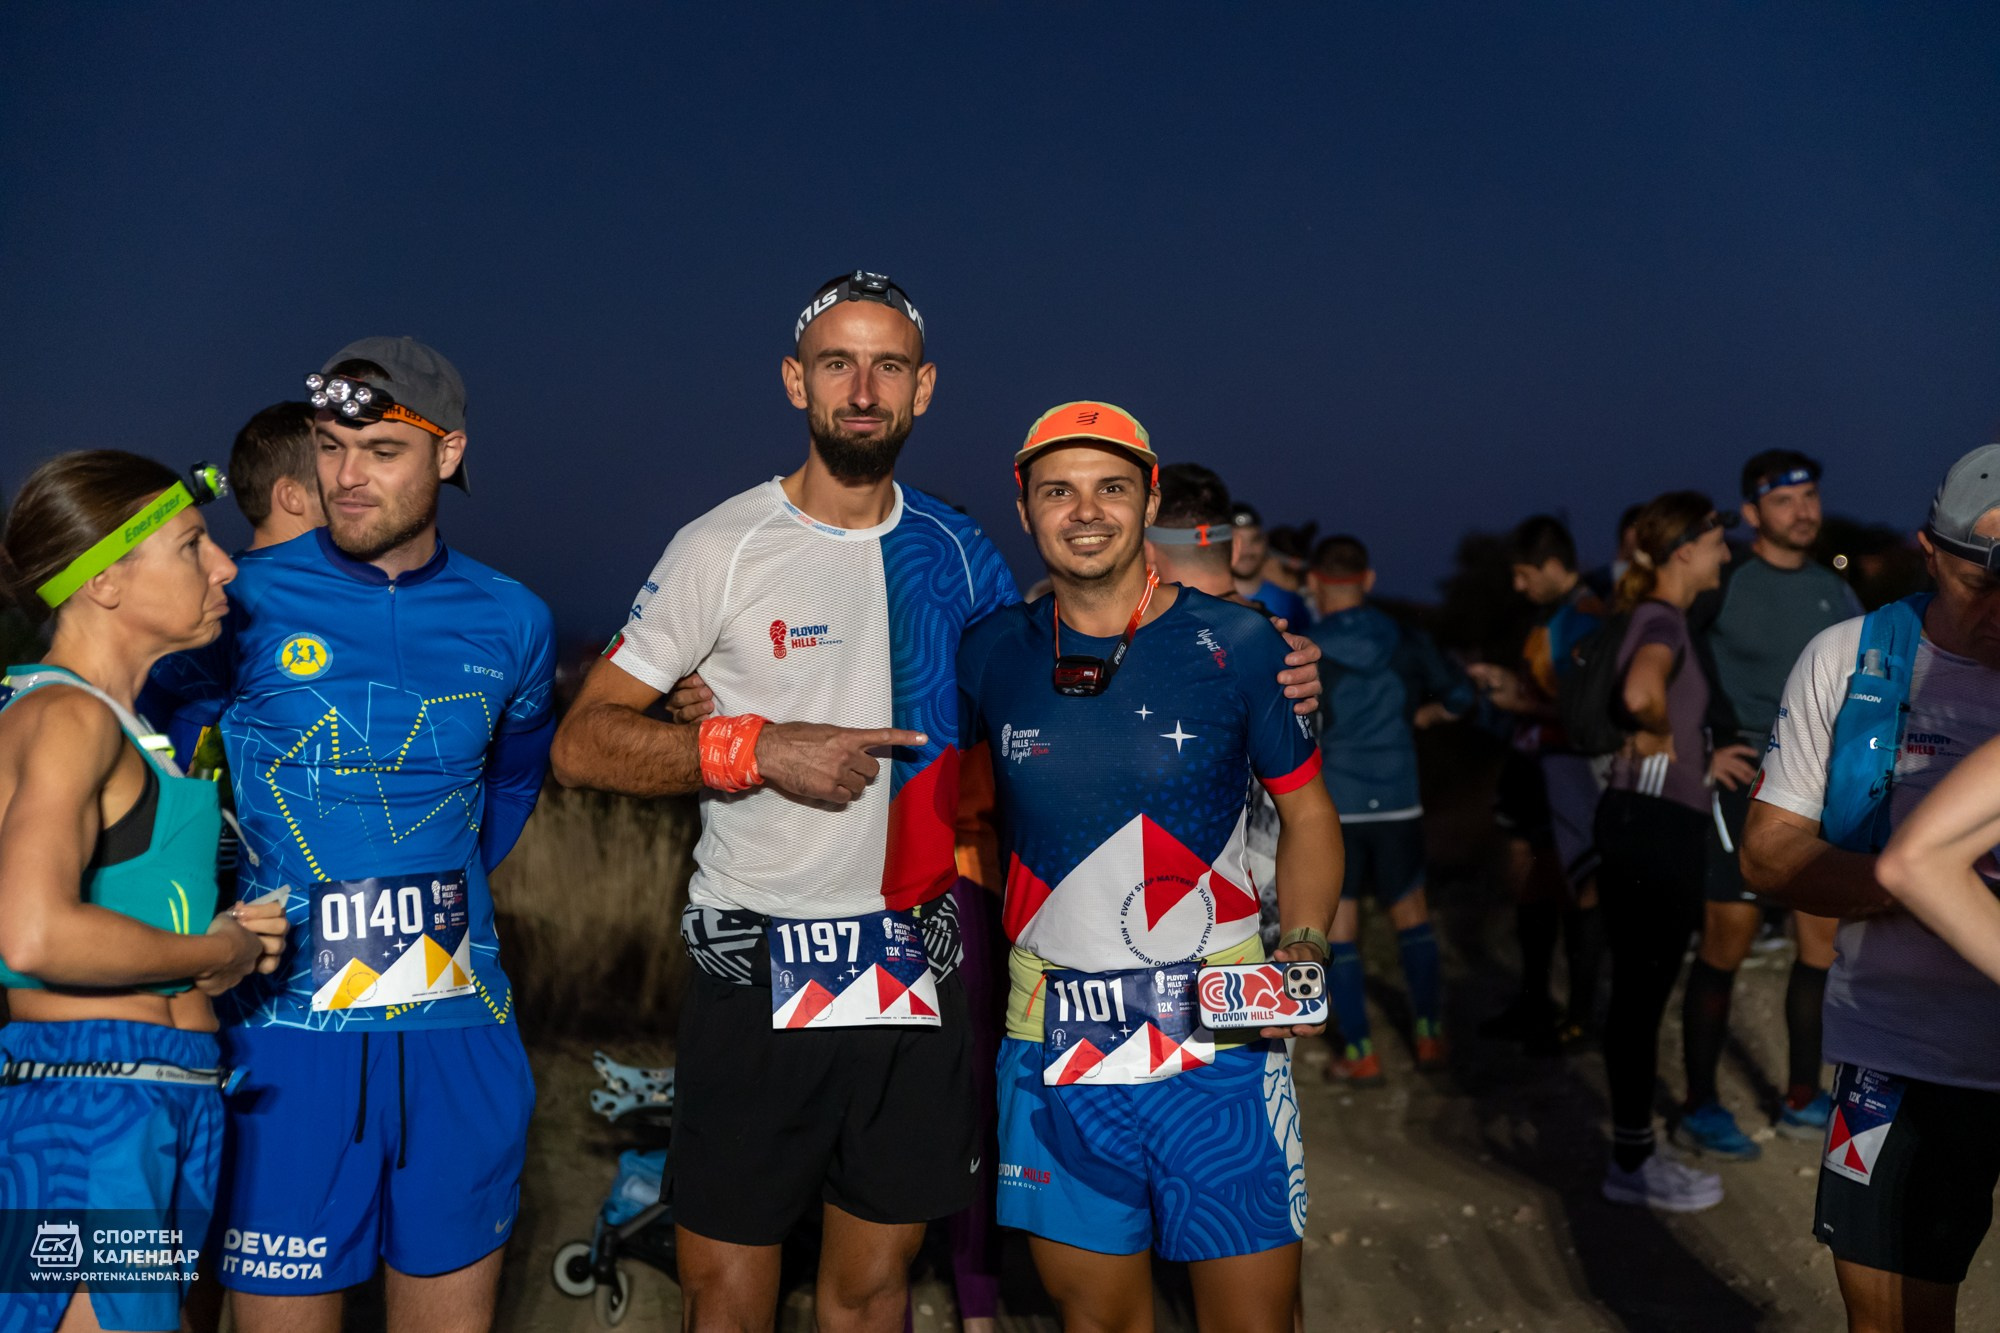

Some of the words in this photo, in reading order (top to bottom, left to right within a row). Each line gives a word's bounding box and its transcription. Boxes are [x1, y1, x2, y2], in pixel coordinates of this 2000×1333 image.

[125, 494, 180, 544] Energizer
[790, 625, 828, 637] PLOVDIV
[791, 637, 816, 649] HILLS
[1012, 729, 1040, 739] PLOVDIV
[1012, 739, 1029, 748] HILLS
[1011, 747, 1031, 765] Night
[1134, 878, 1154, 892] STEP
[1156, 875, 1195, 887] MATTERS
[1120, 890, 1136, 917] EVERY
[1198, 888, 1214, 921] PLOVDIV
[321, 886, 423, 941] 0140
[434, 913, 446, 925] 6K
[777, 921, 860, 963] 1197
[1120, 927, 1133, 946] RUN
[1200, 922, 1213, 945] HILLS
[885, 946, 901, 957] 12K
[1129, 945, 1154, 965] NIGHT
[1196, 945, 1204, 954] IN
[1054, 978, 1127, 1022] 1101
[1157, 1002, 1174, 1013] 12K
[1212, 1011, 1248, 1023] PLOVDIV
[1250, 1010, 1274, 1020] HILLS
[1848, 1091, 1861, 1104] 12K
[1023, 1167, 1051, 1184] HILLS
[223, 1228, 327, 1258] DEV.BG
[222, 1255, 240, 1273] IT
[242, 1259, 323, 1280] РАБОТА
